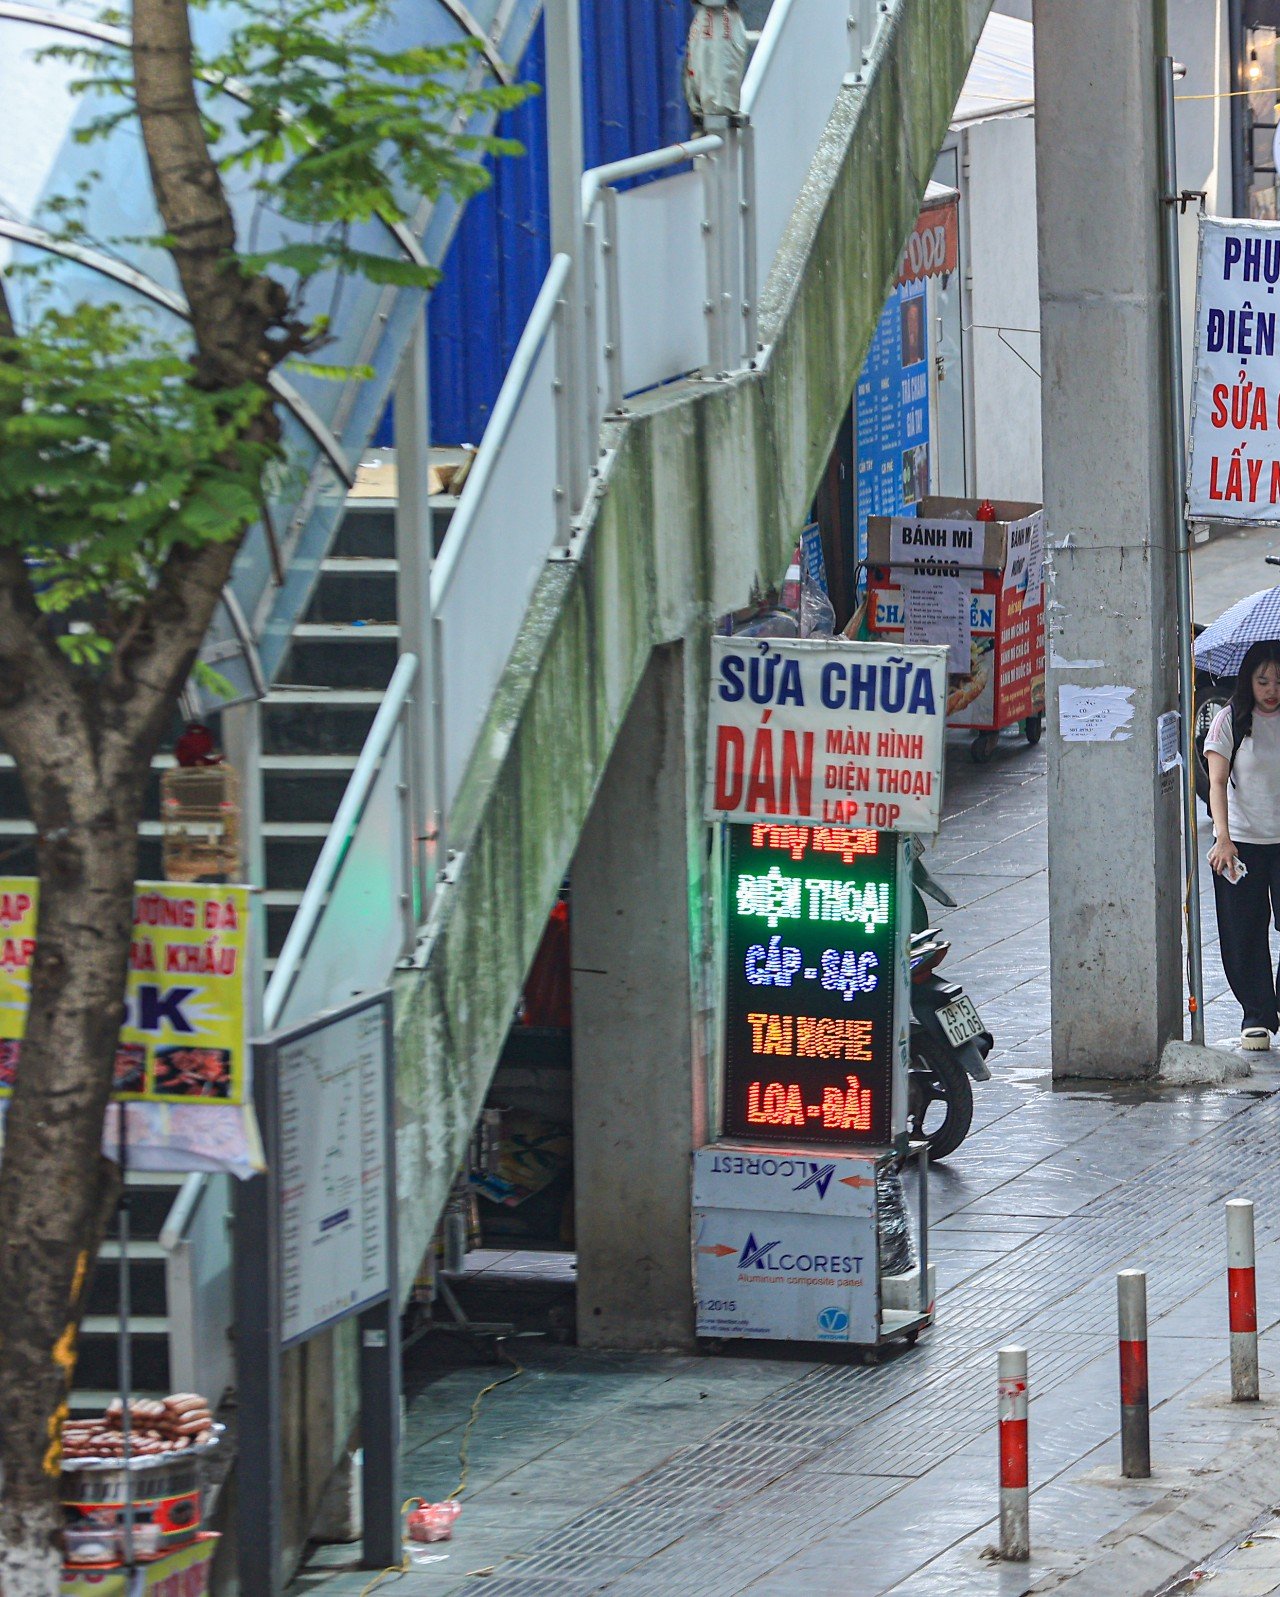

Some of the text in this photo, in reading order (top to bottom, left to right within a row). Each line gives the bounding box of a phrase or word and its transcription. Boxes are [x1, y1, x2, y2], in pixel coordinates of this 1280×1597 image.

[898, 225, 946, 276] OOD
[1223, 236, 1280, 294] PHỤ
[1206, 301, 1275, 365] ĐIỆN
[1211, 370, 1268, 431] SỬA
[1209, 442, 1263, 502] LẤY
[902, 524, 973, 549] BÁNH MÌ
[914, 555, 960, 577] NÓNG
[970, 597, 992, 627] ỂN
[718, 641, 936, 715] SỬA CHỮA
[713, 708, 814, 816] DÁN
[826, 725, 923, 759] MÀN HÌNH
[824, 761, 932, 801] ĐIỆN THOẠI
[823, 799, 900, 827] LAP TOP
[735, 866, 889, 933] ĐIỆN THOẠI
[745, 935, 802, 987] CÁP
[820, 948, 879, 1001] SẠC
[123, 986, 195, 1032] K
[942, 1000, 971, 1025] 29-Y5
[949, 1015, 981, 1043] 102.05
[747, 1013, 873, 1061] TAI NGHE
[747, 1082, 805, 1126] LOA
[711, 1156, 836, 1200] ALCOREST
[737, 1232, 864, 1274] ALCOREST
[738, 1273, 864, 1288] Aluminum composite panel
